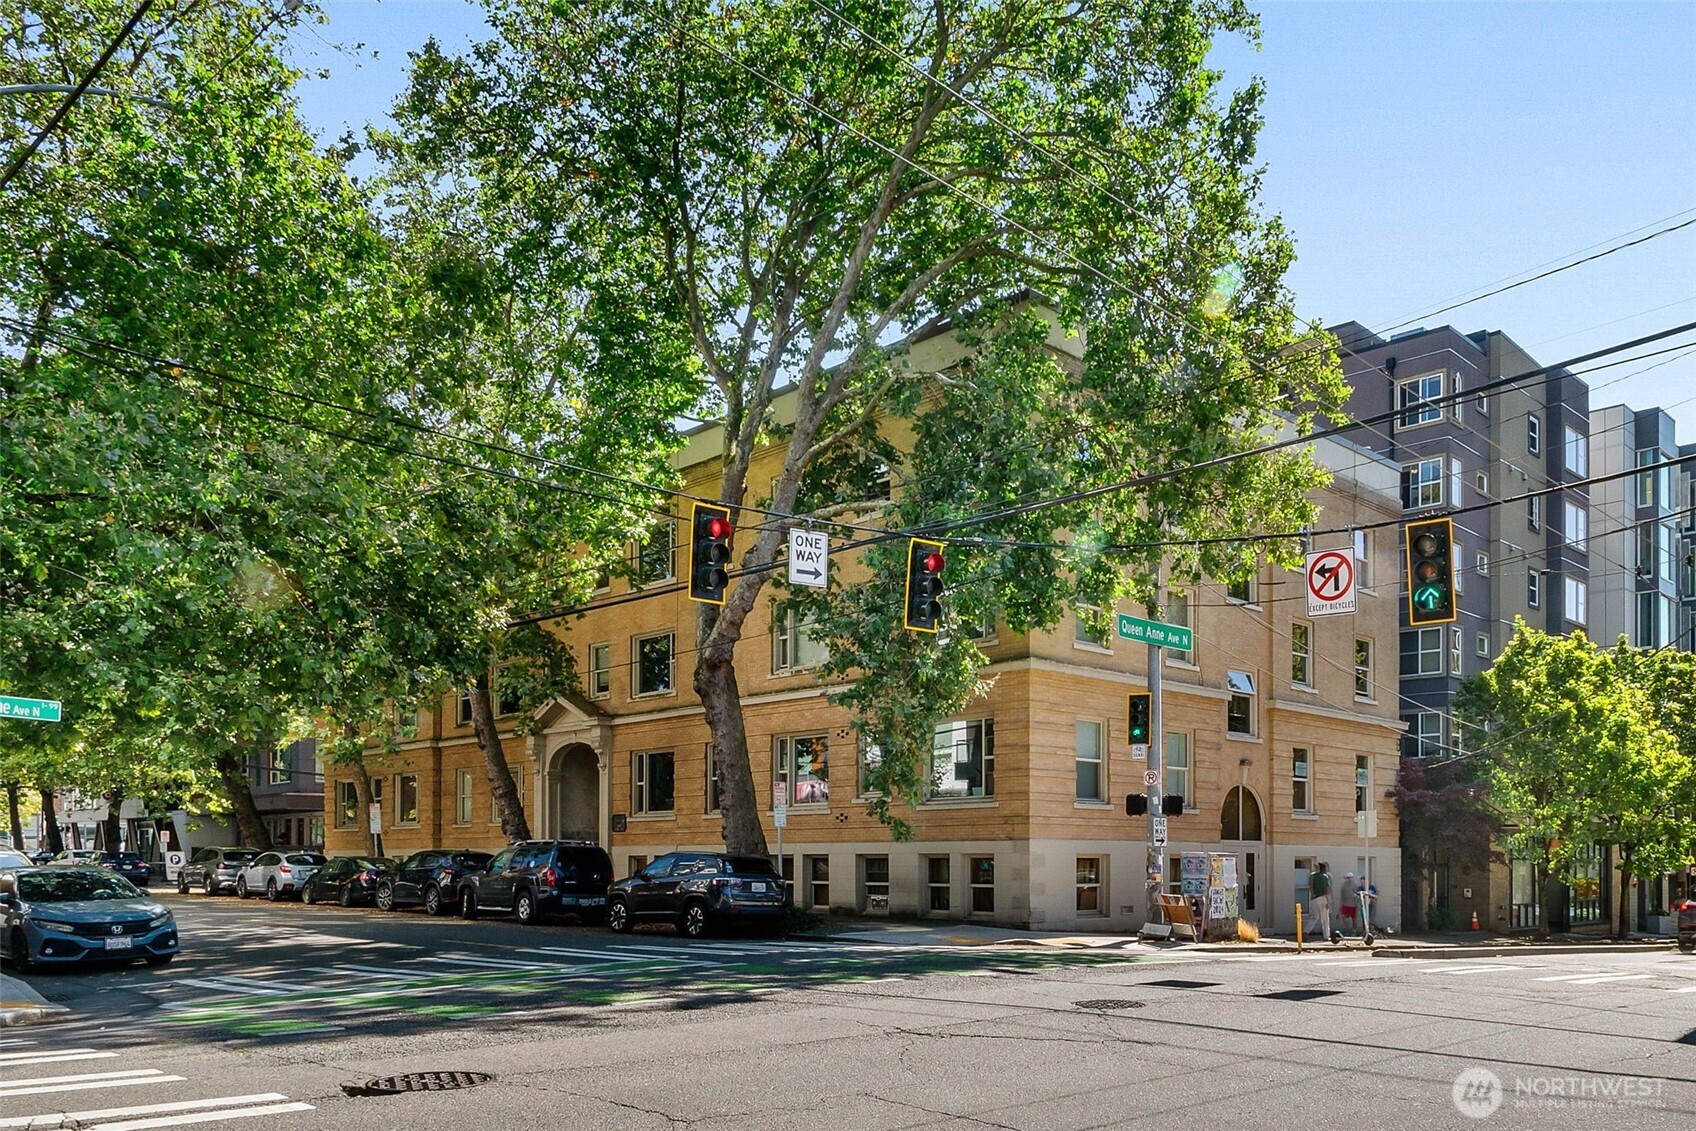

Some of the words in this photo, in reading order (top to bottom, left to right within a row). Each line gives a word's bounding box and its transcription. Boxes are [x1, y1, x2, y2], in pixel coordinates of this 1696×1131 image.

[795, 535, 822, 550] ONE
[795, 549, 822, 563] WAY
[1309, 603, 1328, 612] EXCEPT
[1329, 600, 1354, 610] BICYCLES
[1121, 620, 1144, 637] Queen
[1146, 626, 1164, 641] Anne
[1167, 632, 1179, 645] Ave
[1182, 634, 1188, 646] N
[12, 704, 30, 716] Ave
[33, 706, 40, 717] N
[1155, 819, 1166, 827] ONE
